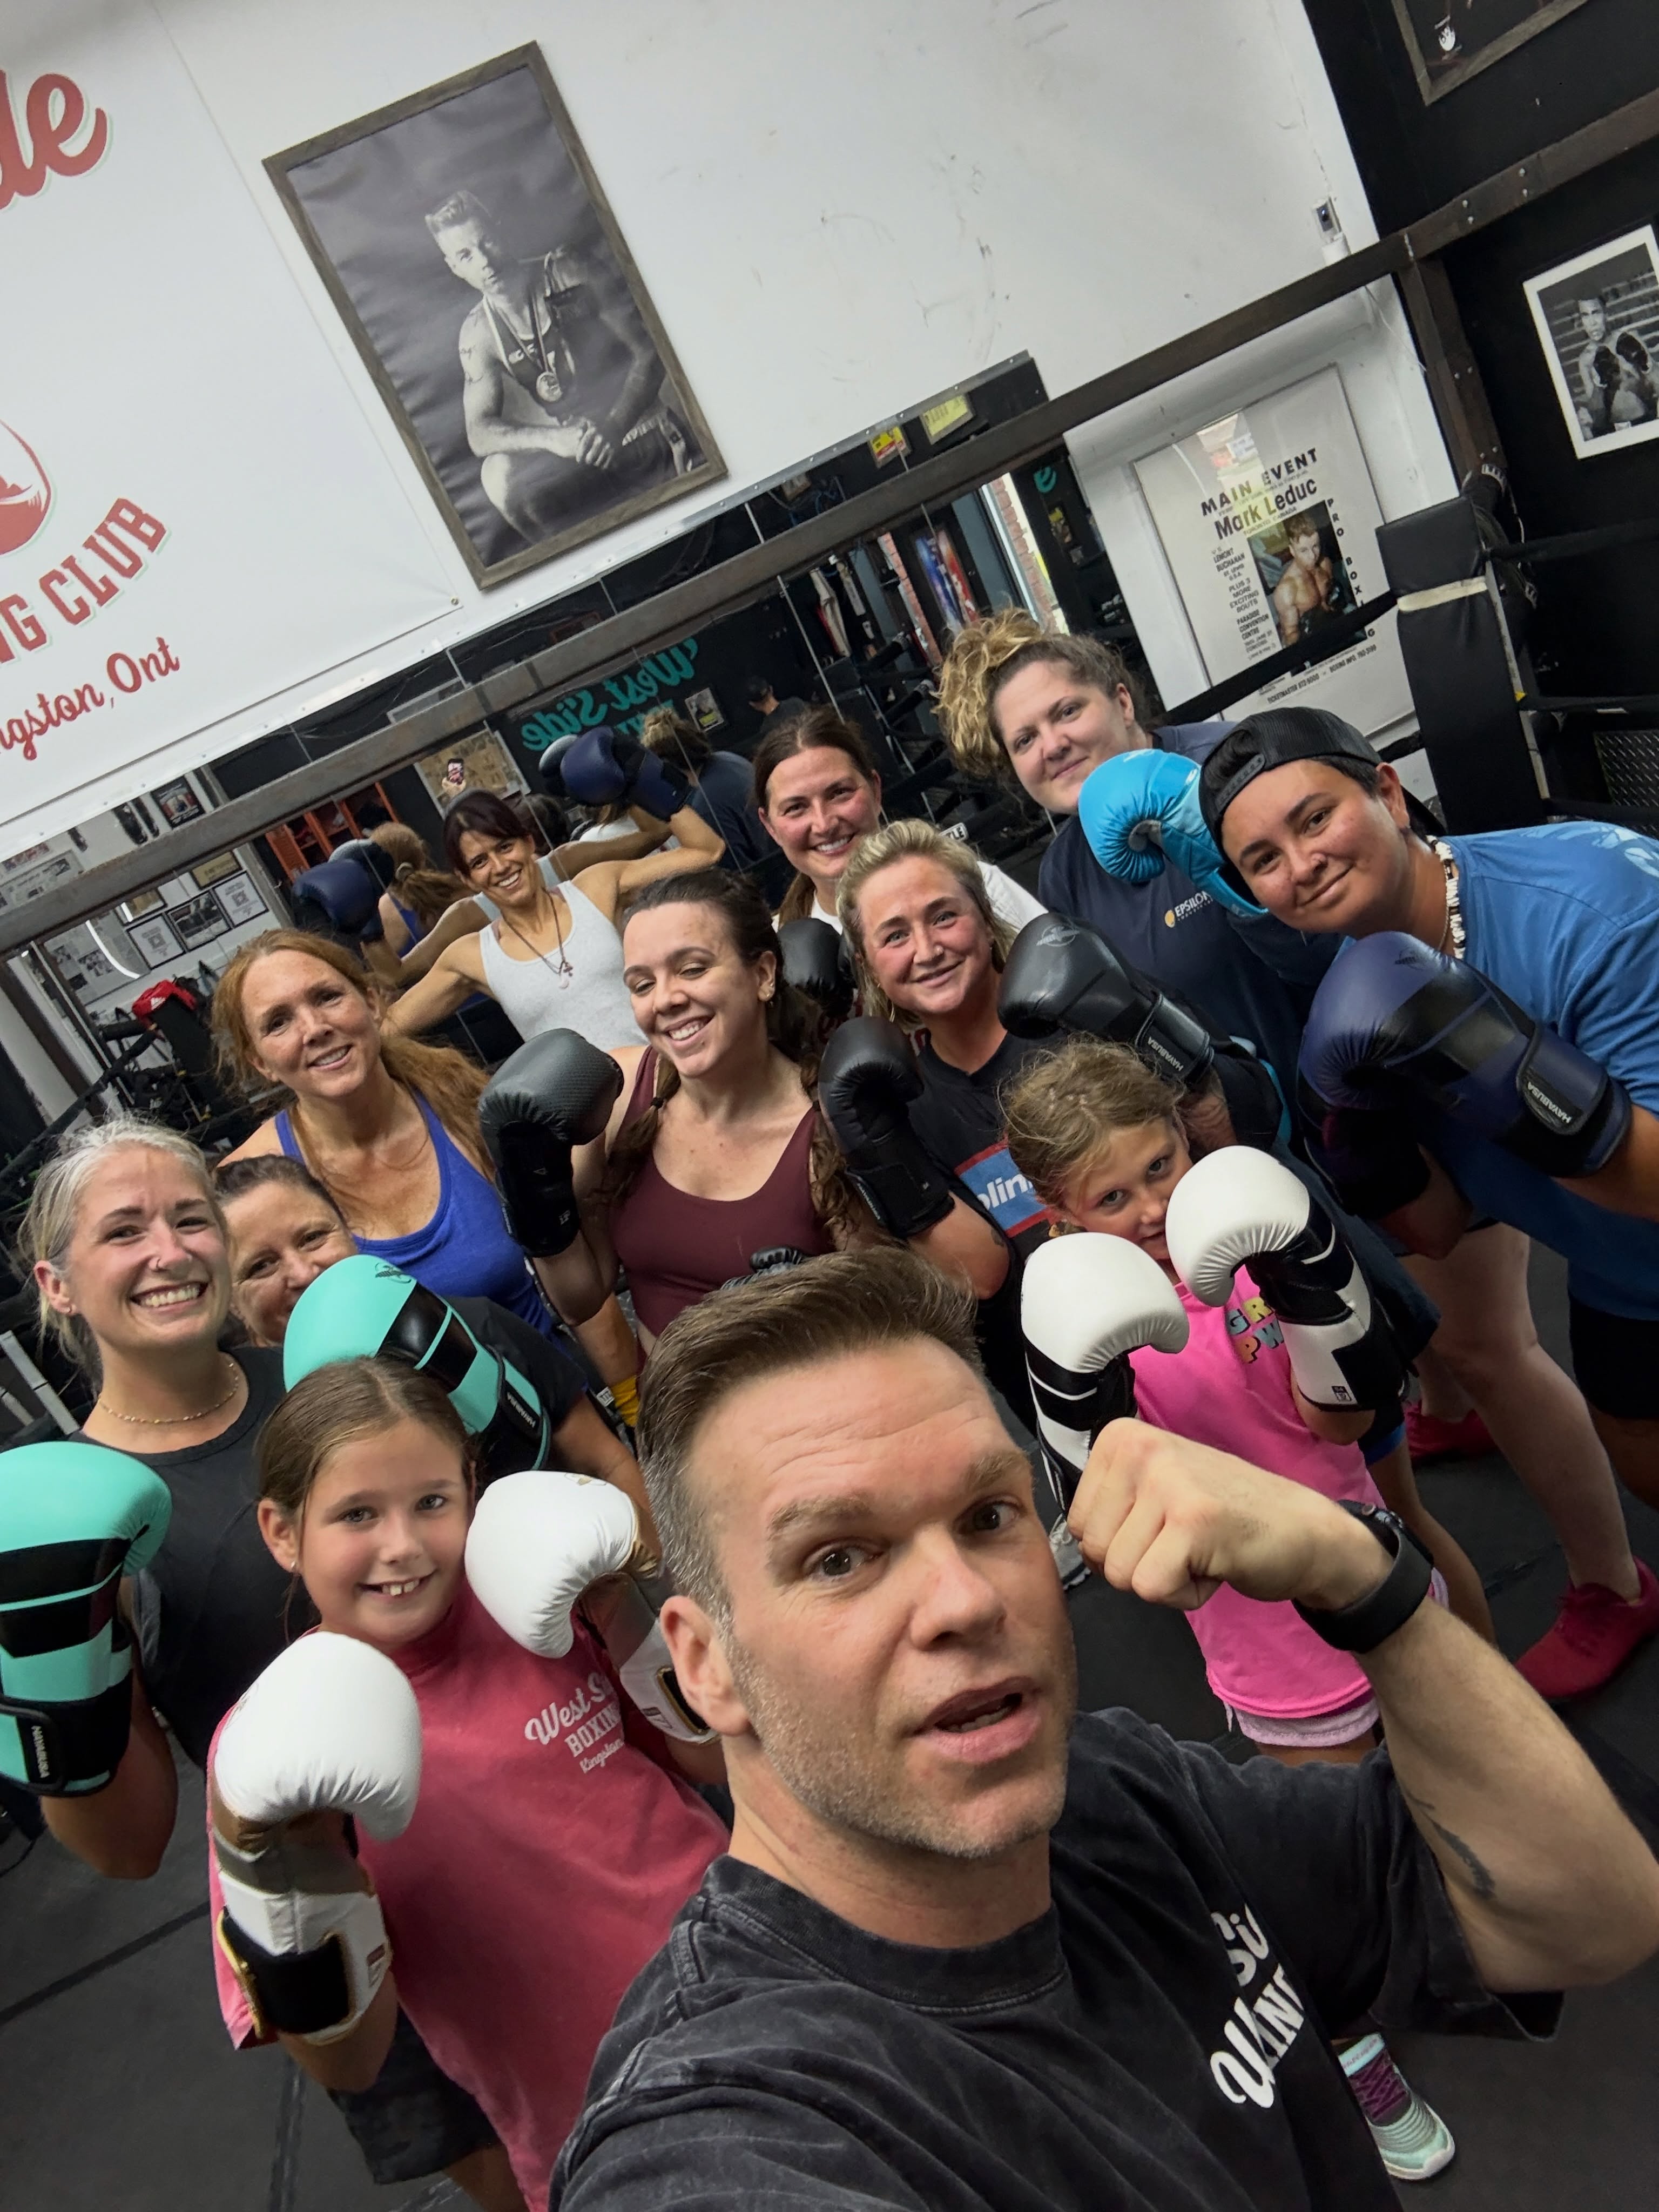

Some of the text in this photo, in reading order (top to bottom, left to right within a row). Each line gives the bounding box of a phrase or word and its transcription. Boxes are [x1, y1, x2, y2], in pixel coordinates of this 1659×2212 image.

[1201, 480, 1252, 516] MAIN
[1262, 448, 1318, 486] EVENT
[1214, 504, 1262, 540] Mark
[1263, 478, 1317, 515] Leduc
[0, 497, 167, 664] G CLUB
[106, 636, 180, 693] Ont
[1148, 1036, 1184, 1072] HAYABUSA
[1527, 1081, 1573, 1124] HAYABUSA
[524, 1688, 591, 1745] West
